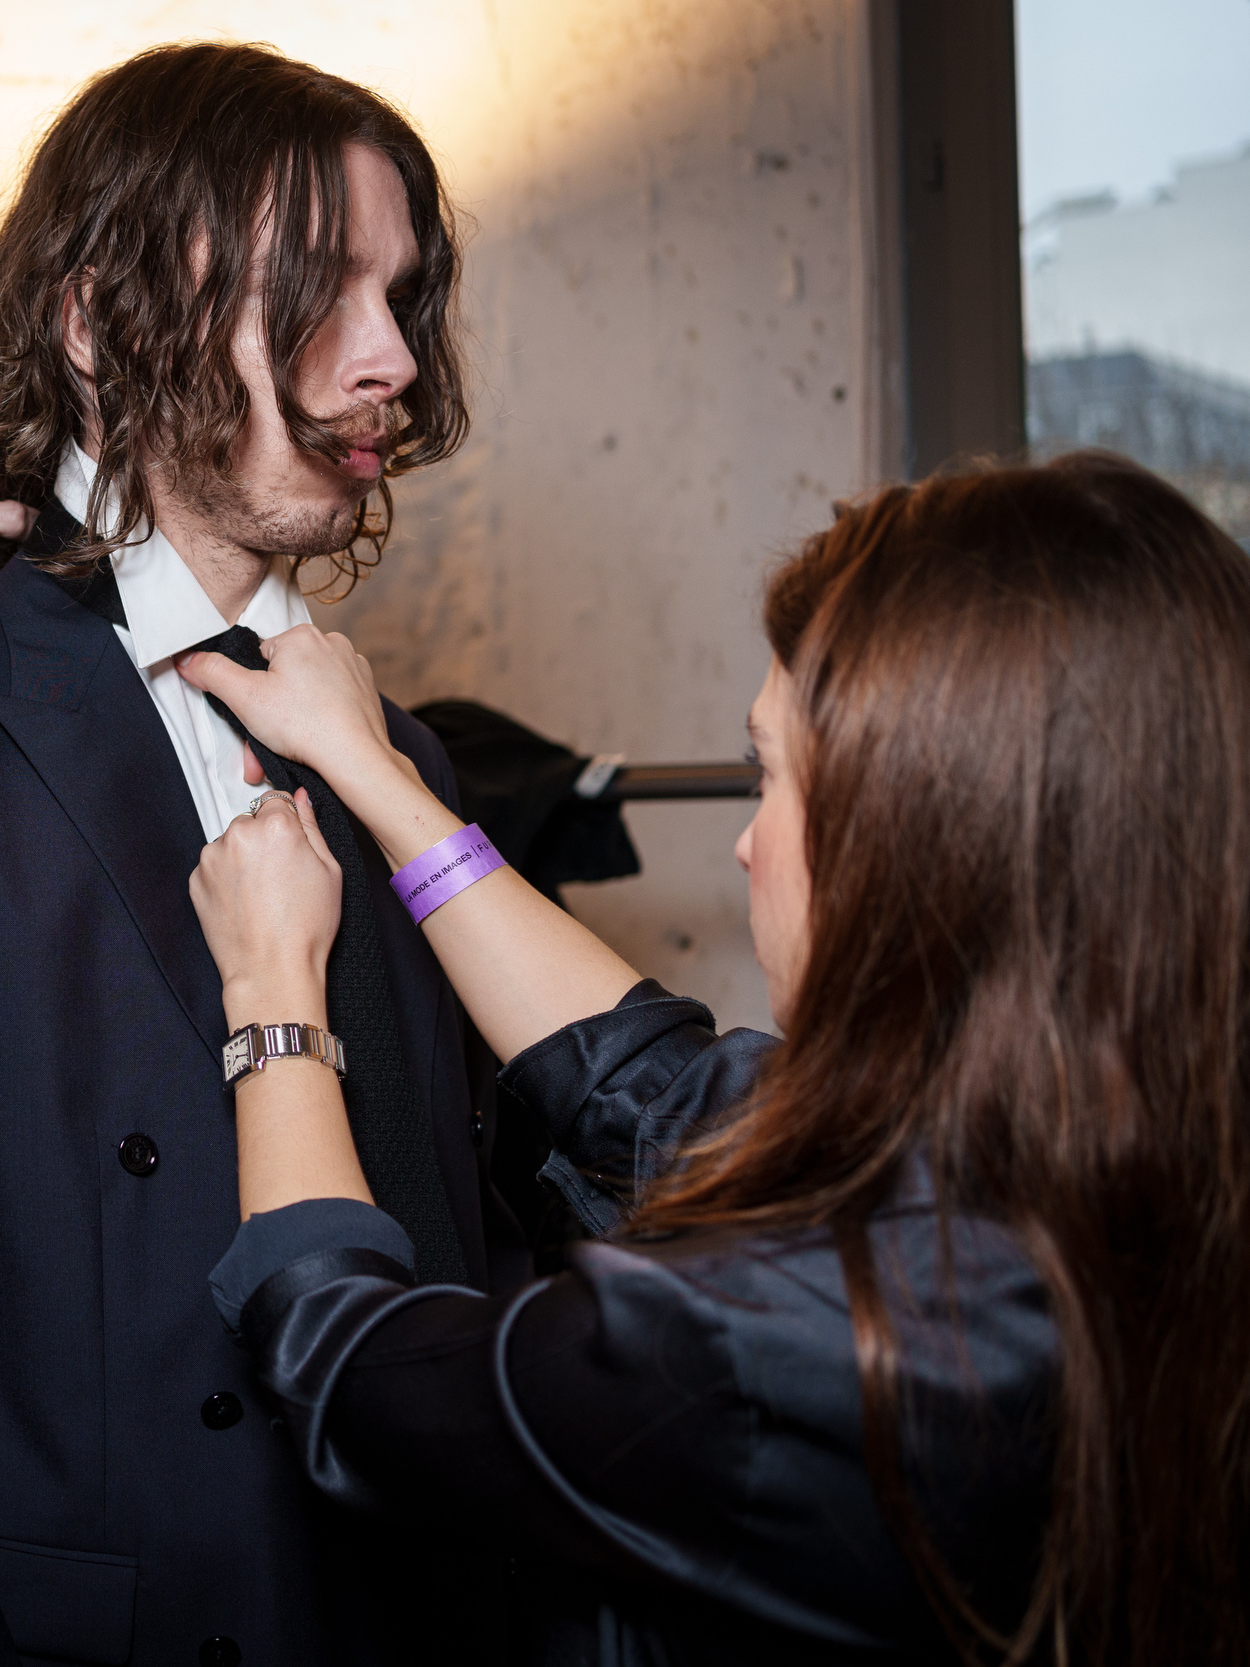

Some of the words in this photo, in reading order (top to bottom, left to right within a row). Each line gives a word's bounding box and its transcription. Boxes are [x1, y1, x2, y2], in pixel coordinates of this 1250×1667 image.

[405, 894, 413, 903] LA
[411, 879, 431, 898] MODE
[429, 871, 442, 884] EN
[442, 852, 472, 875] IMAGES
